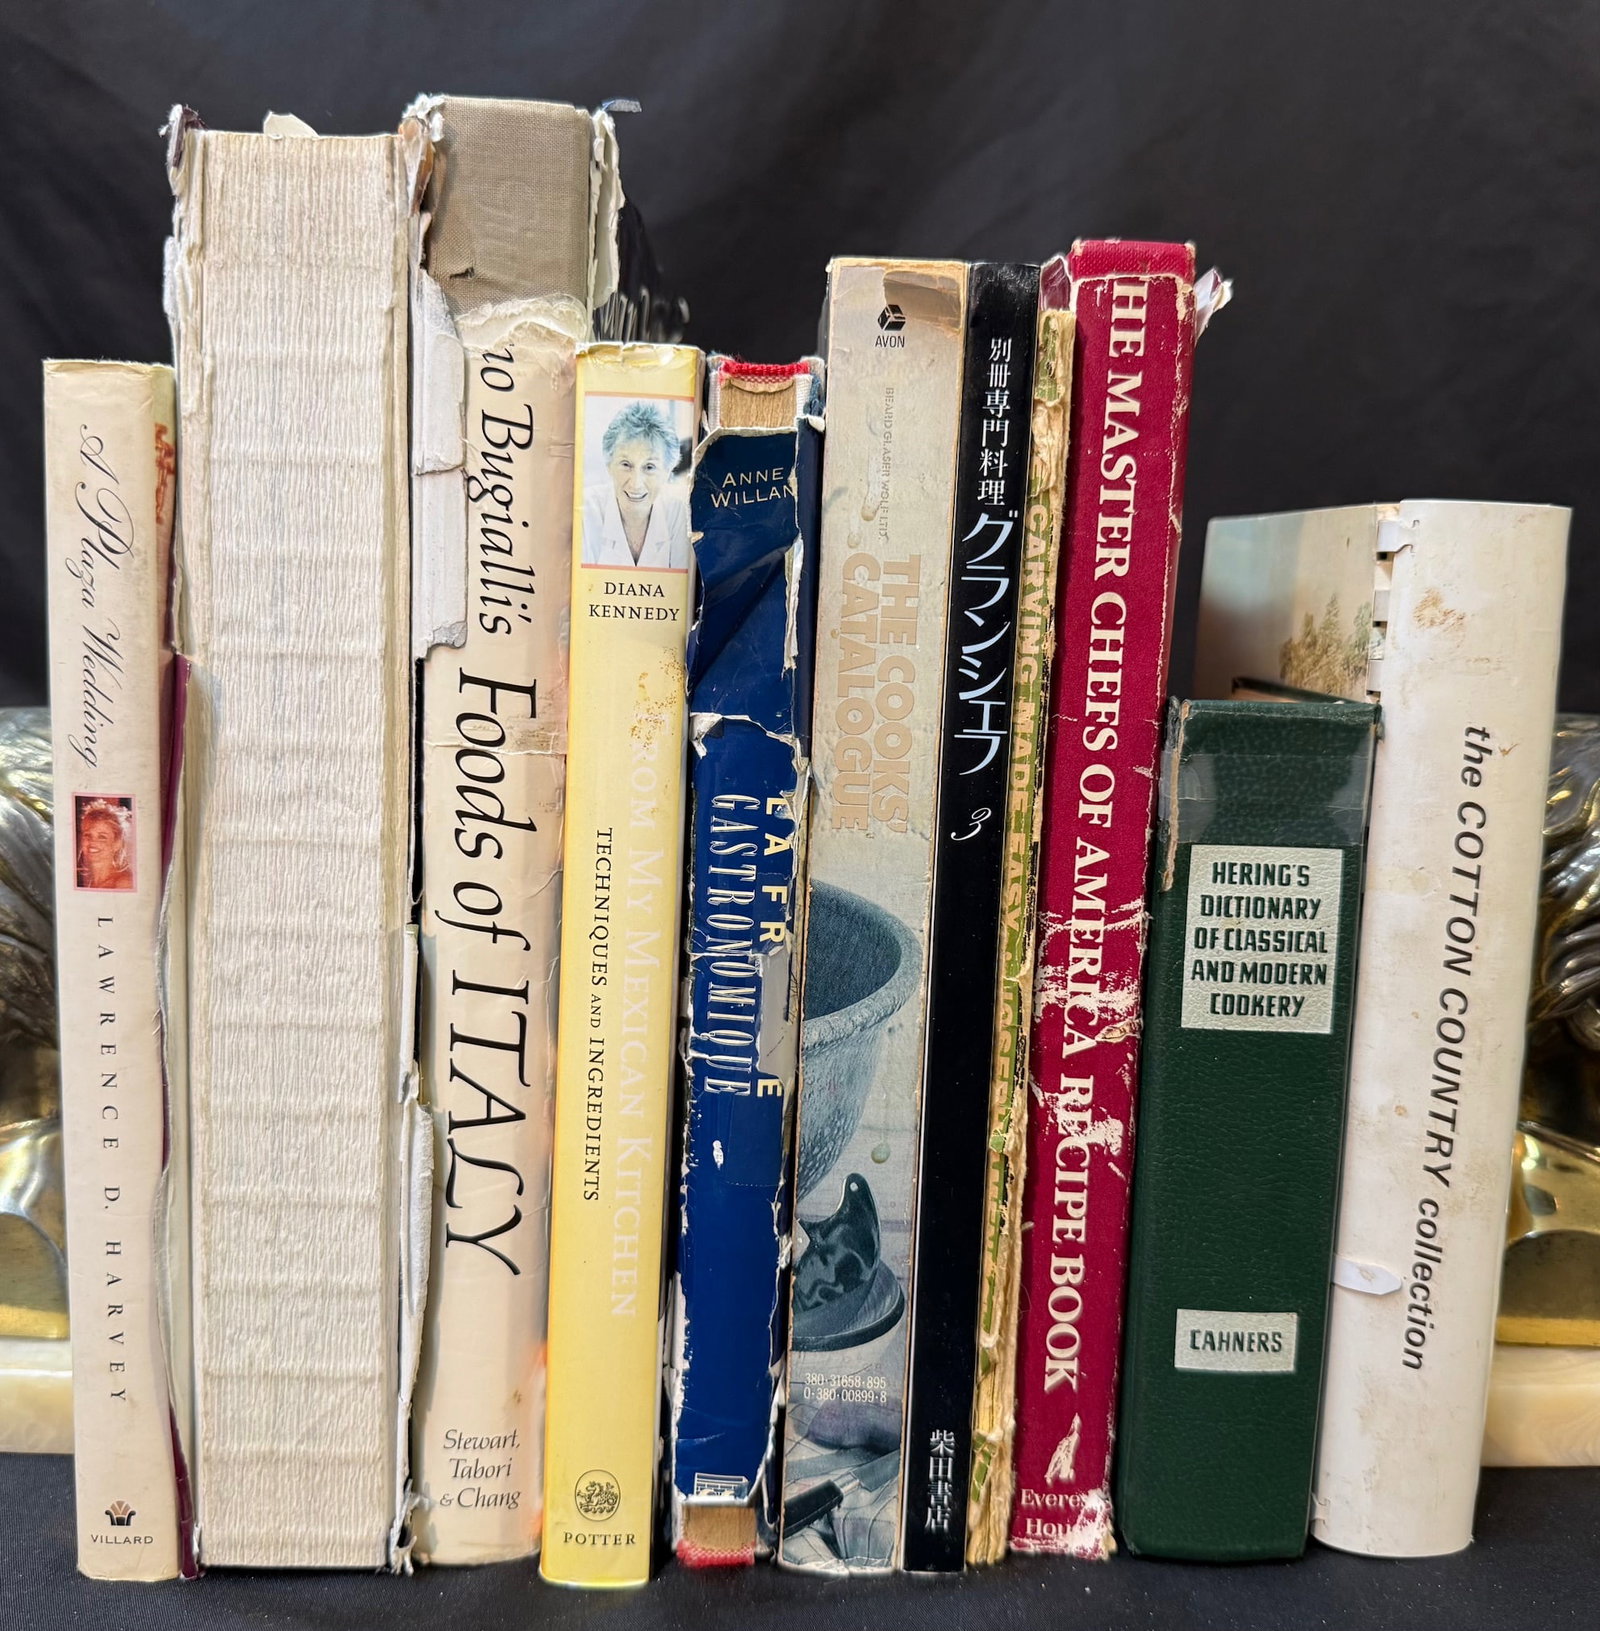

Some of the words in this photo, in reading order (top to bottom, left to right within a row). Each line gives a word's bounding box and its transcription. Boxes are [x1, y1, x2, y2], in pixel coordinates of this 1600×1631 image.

[875, 335, 906, 348] AVON
[1109, 275, 1149, 358] HE
[881, 430, 893, 477] GLASER
[883, 386, 895, 429] BEARD
[977, 337, 1013, 506] 別冊専門料理
[80, 423, 119, 490] A
[711, 484, 796, 508] WILLAN
[722, 467, 785, 488] ANNE
[1094, 370, 1143, 582] MASTER
[65, 480, 134, 611] Plaza
[466, 403, 536, 635] Bugialli's
[588, 604, 680, 621] KENNEDY
[604, 582, 665, 598] DIANA
[879, 554, 922, 646] THE
[1018, 504, 1048, 684] CARVING
[953, 508, 1019, 776] グランシェフ
[1082, 591, 1127, 751] CHEFS
[73, 615, 119, 770] Wedding
[831, 552, 882, 831] CATALOGUE
[453, 667, 538, 859] Foods
[871, 654, 916, 834] COOKS'
[1011, 702, 1036, 815] MADE
[1460, 726, 1493, 788] the
[950, 807, 992, 841] 3
[1078, 763, 1116, 829] OF
[434, 881, 531, 951] of
[589, 827, 613, 986] TECHNIQUES
[626, 848, 664, 915] MY
[1004, 832, 1026, 932] EASY
[1200, 894, 1321, 920] DICTIONARY
[1211, 861, 1310, 887] HERING'S
[1442, 801, 1487, 976] COTTON
[702, 794, 761, 1096] GASTRONOMIQUE
[1061, 836, 1111, 1059] AMERICA
[1190, 959, 1235, 983] AND
[1238, 961, 1328, 985] MODERN
[1193, 927, 1220, 950] OF
[1222, 928, 1328, 953] CLASSICAL
[97, 916, 120, 1150] LAWRENCE
[590, 993, 602, 1028] AND
[617, 930, 662, 1118] MEXICAN
[757, 884, 789, 1098] FRE
[1209, 992, 1306, 1018] COOKERY
[445, 969, 531, 1276] ITALY
[583, 1037, 605, 1200] INGREDIENTS
[1422, 987, 1469, 1189] COUNTRY
[103, 1185, 121, 1210] D.
[1051, 1072, 1095, 1244] RECIPE
[610, 1136, 653, 1317] KITCHEN
[105, 1240, 127, 1401] HARVEY
[1043, 1252, 1085, 1394] BOOK
[1402, 1197, 1443, 1371] collection
[1189, 1329, 1283, 1353] CAHNERS
[443, 1428, 521, 1450] Stewart,
[449, 1457, 513, 1479] Tabori
[924, 1428, 956, 1533] 柴田書店
[90, 1533, 154, 1545] VILLARD
[440, 1493, 454, 1507] &
[457, 1487, 522, 1510] Chang
[563, 1531, 636, 1546] POTTER
[1020, 1488, 1085, 1508] Evere
[1026, 1517, 1075, 1537] Hou
